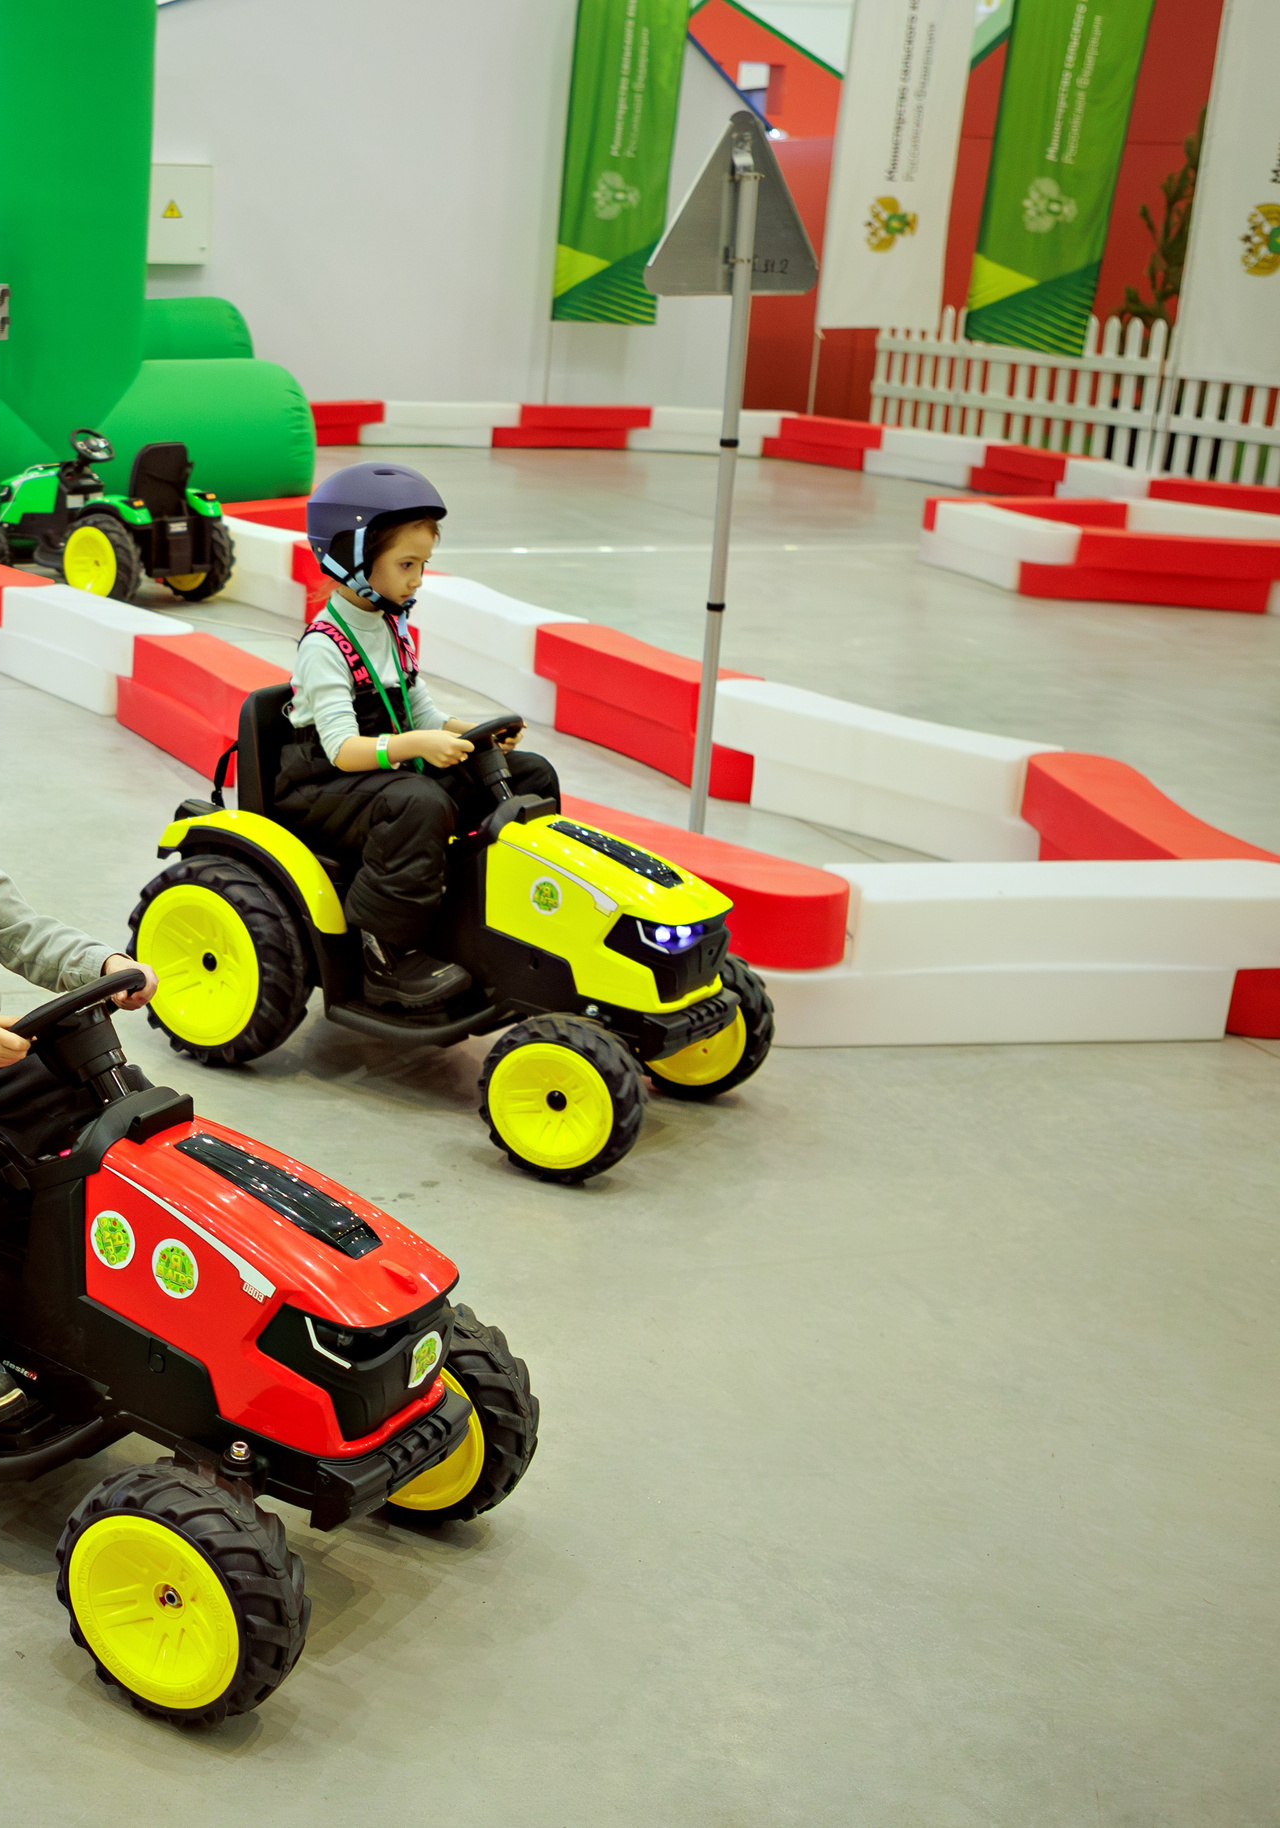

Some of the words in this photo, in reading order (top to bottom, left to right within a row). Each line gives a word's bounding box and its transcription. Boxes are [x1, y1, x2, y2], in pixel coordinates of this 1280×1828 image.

[102, 1230, 117, 1266] АГРО
[170, 1253, 181, 1272] Я
[166, 1268, 194, 1290] АГРО
